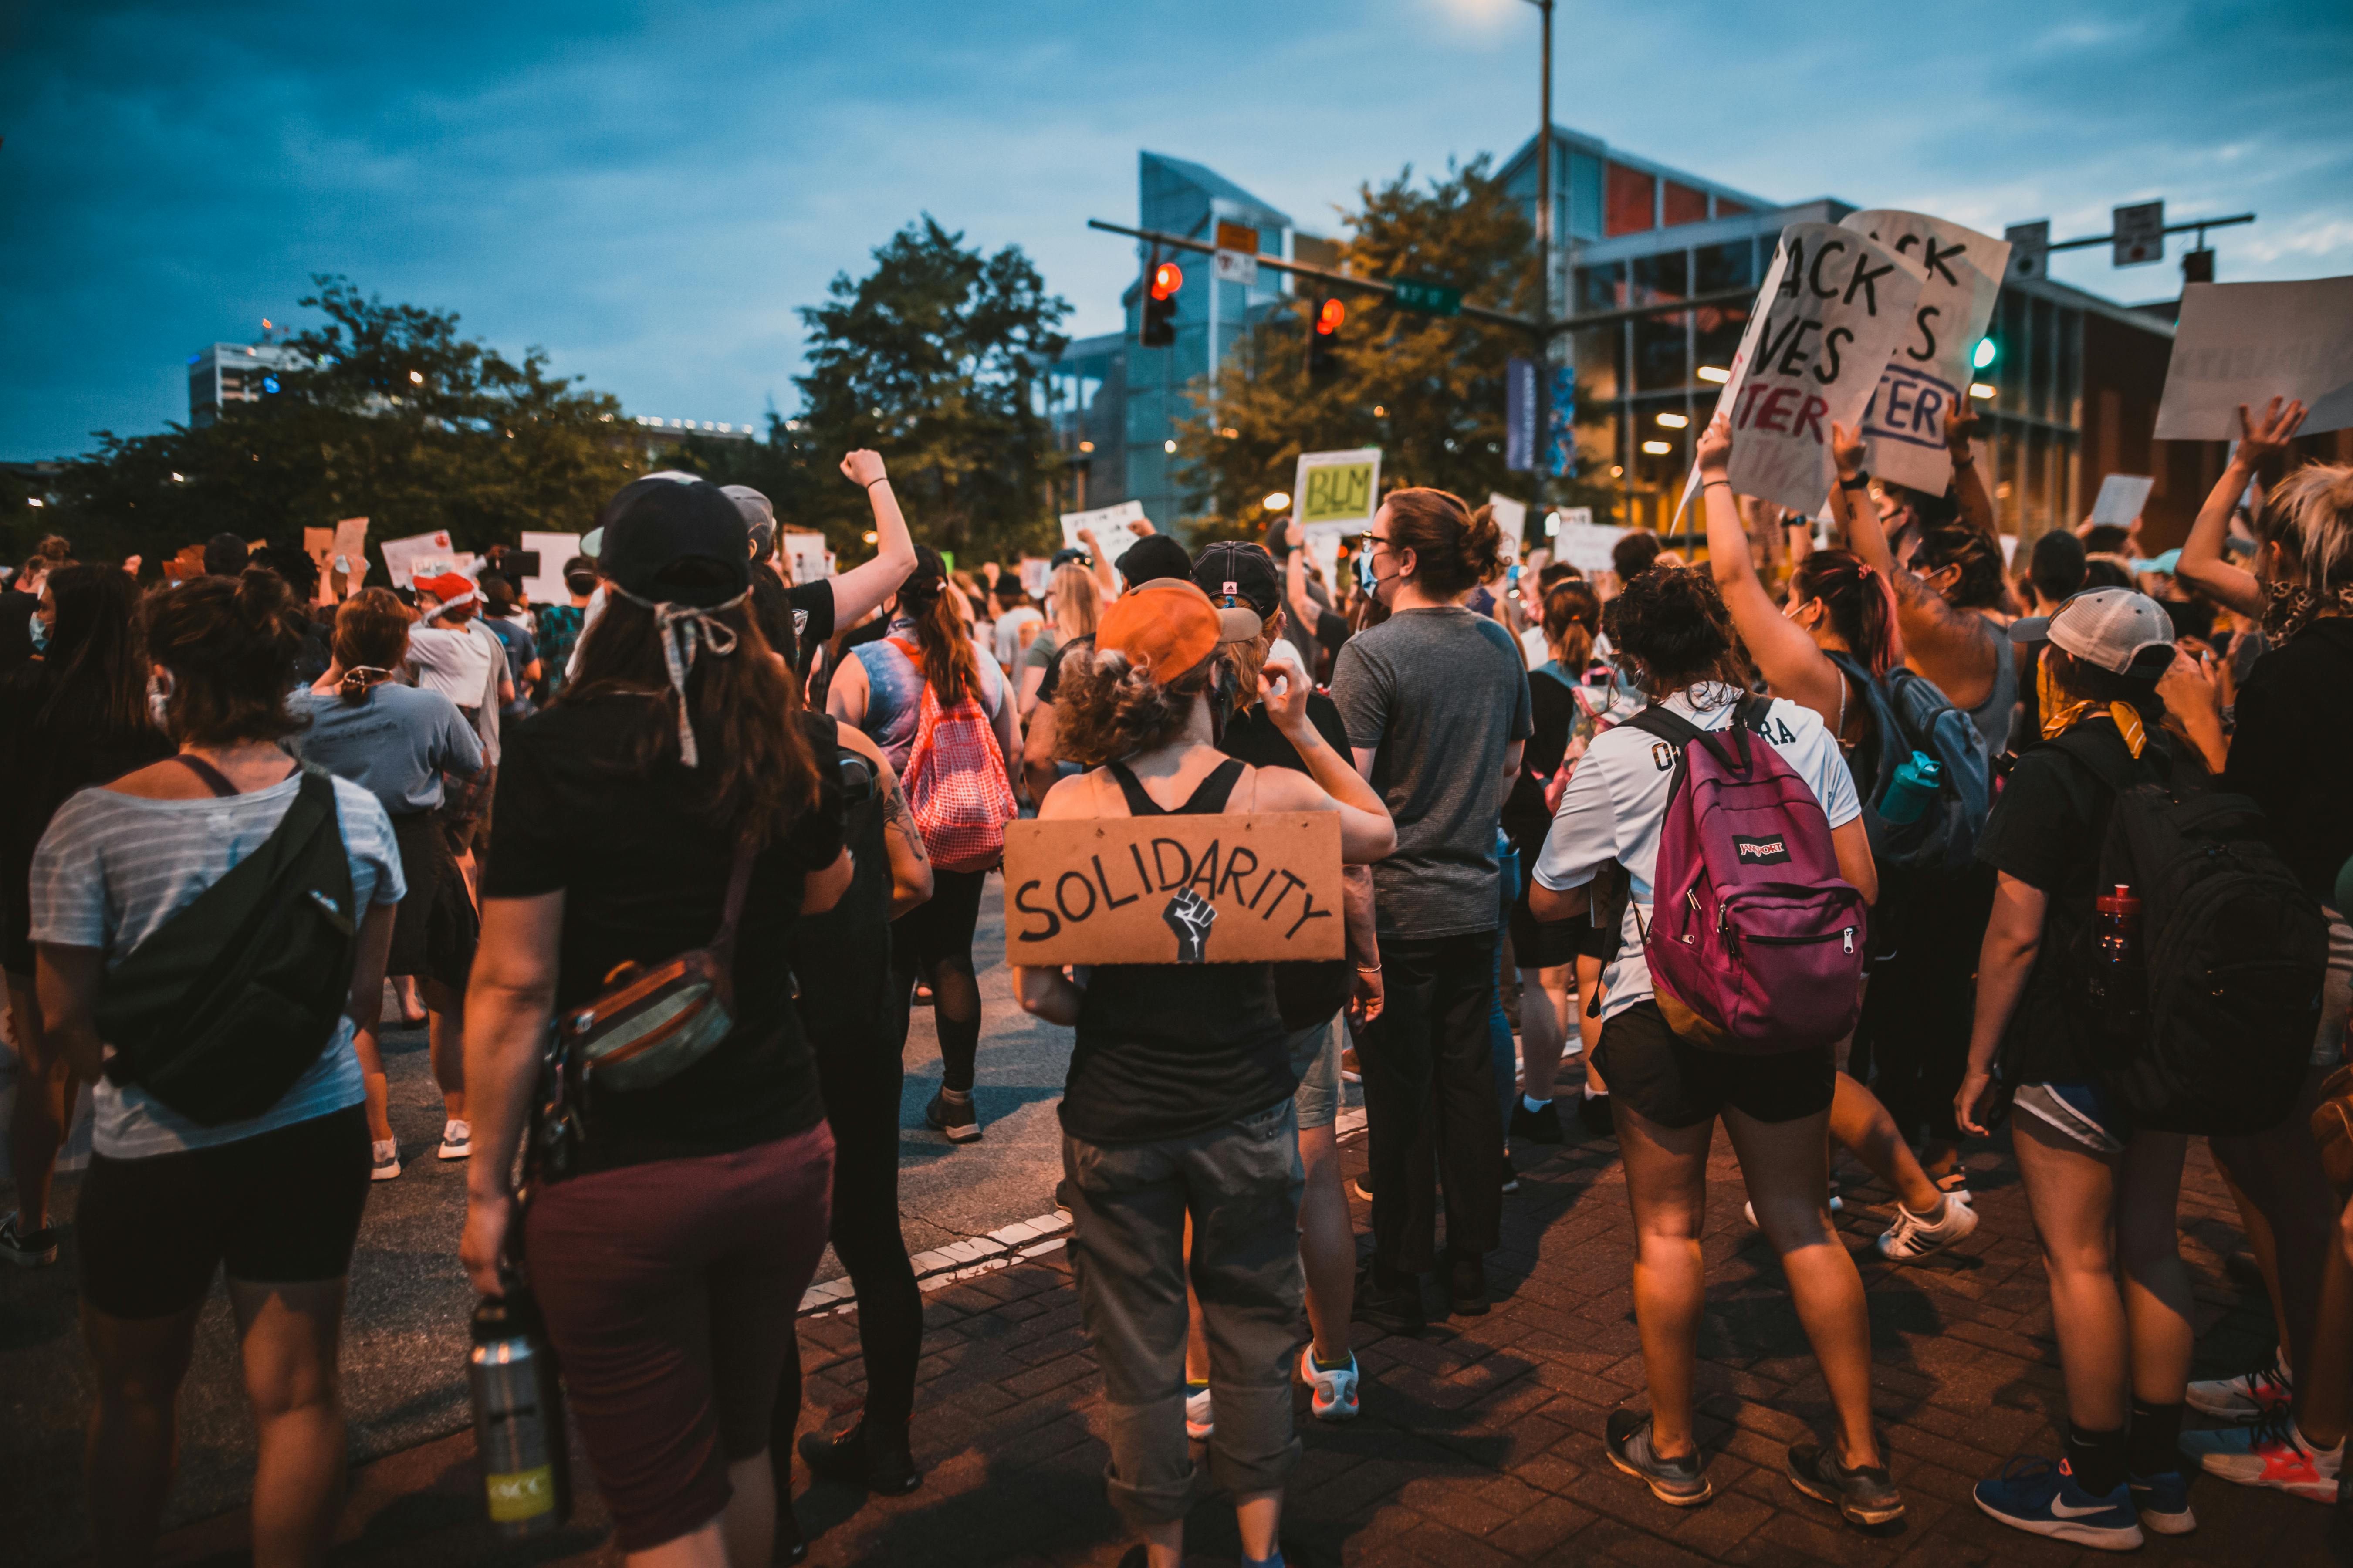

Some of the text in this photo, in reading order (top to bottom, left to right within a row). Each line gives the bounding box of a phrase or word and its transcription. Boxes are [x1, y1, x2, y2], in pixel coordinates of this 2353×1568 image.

[1307, 468, 1371, 515] BLM
[1739, 842, 1784, 857] JANSPORT
[1015, 838, 1332, 941] SOLIDARITY
